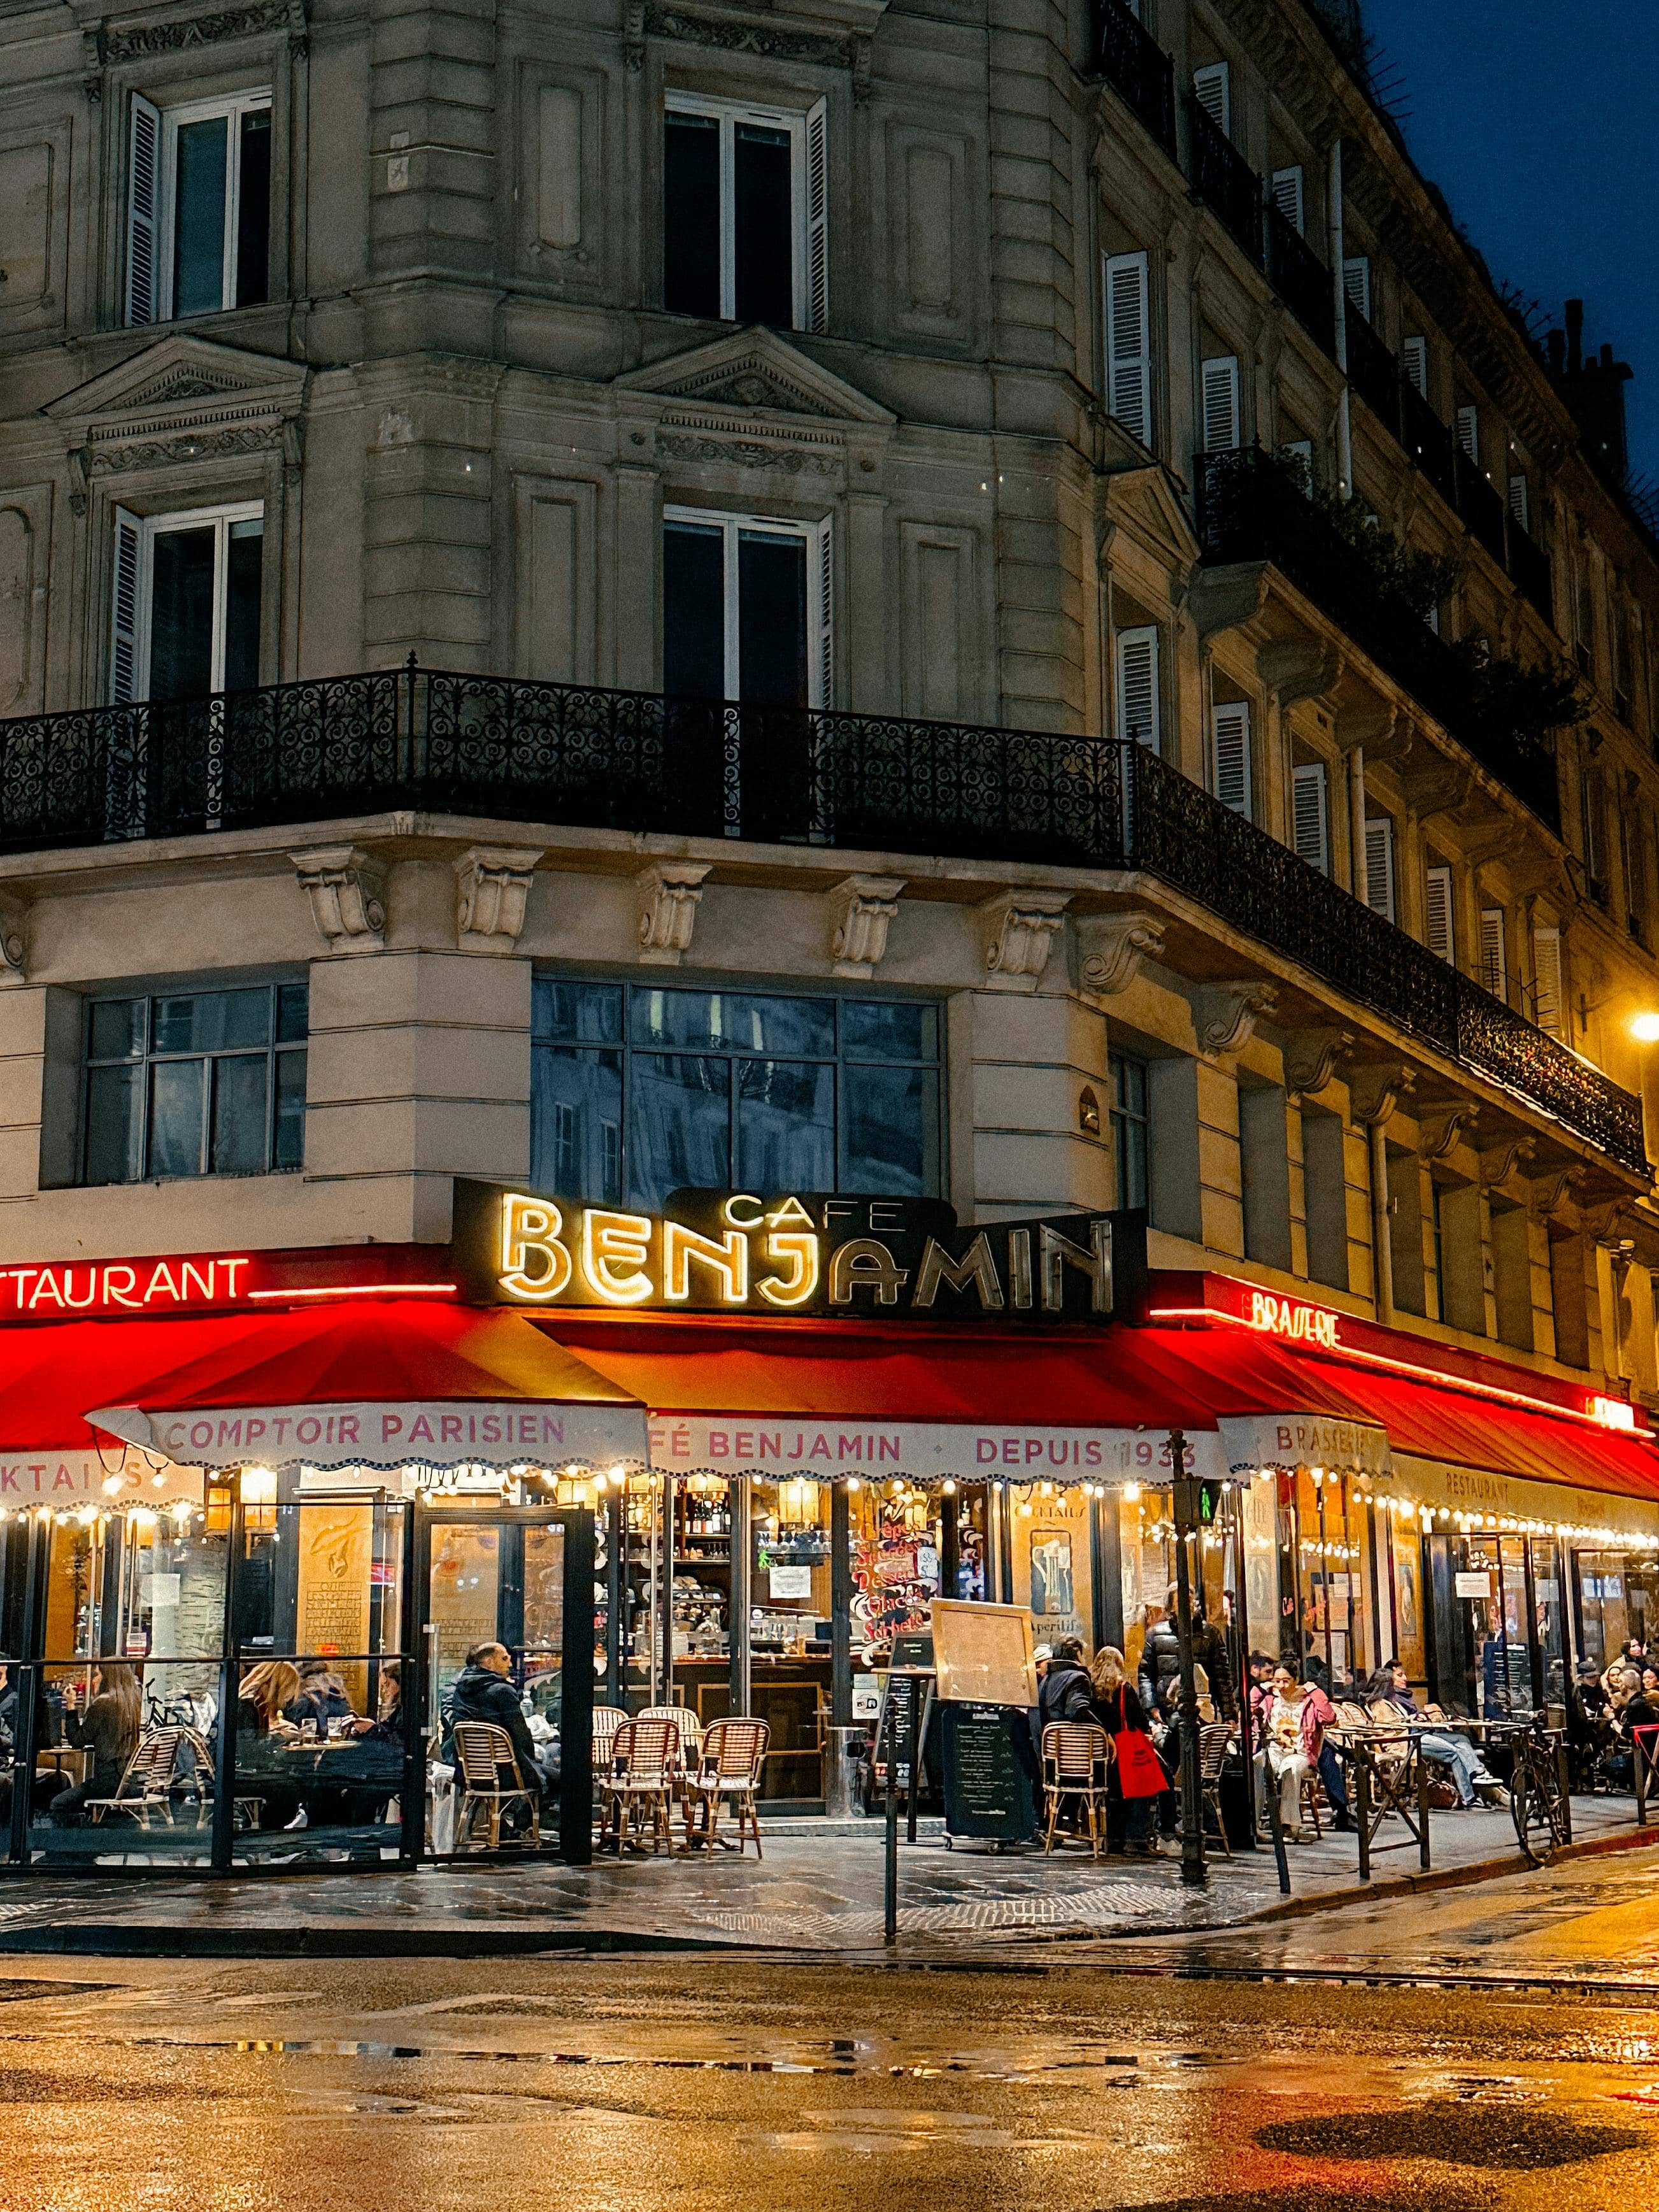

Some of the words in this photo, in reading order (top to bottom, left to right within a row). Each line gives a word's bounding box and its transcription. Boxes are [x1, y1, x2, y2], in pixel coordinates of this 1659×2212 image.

[498, 1192, 1114, 1315] BENJAMIN
[0, 1259, 249, 1309] TAURANT
[164, 1416, 359, 1451] COMPTOIR
[382, 1413, 565, 1444] PARISIEN
[709, 1431, 900, 1461] BENJAMIN
[976, 1438, 1103, 1466] DEPUIS
